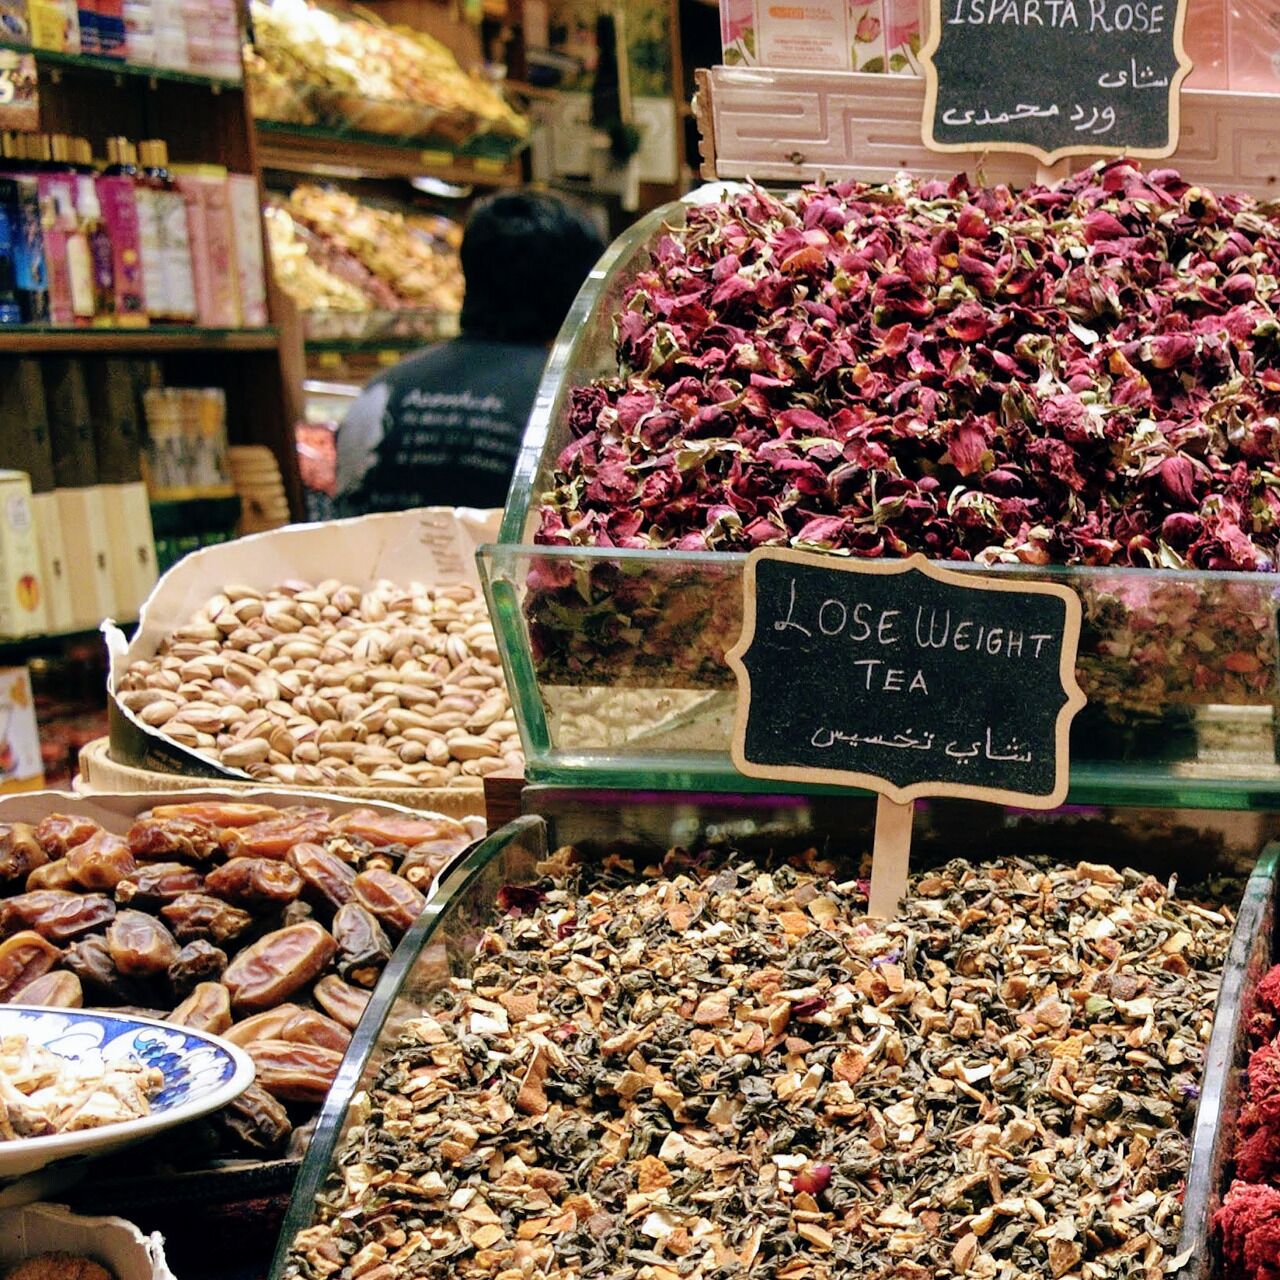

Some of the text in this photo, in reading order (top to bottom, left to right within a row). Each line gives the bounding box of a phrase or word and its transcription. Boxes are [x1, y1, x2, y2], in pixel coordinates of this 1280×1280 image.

[947, 0, 1165, 33] ISPARTA ROSE
[775, 578, 1052, 659] LOSE WEIGHT
[854, 659, 929, 696] TEA
